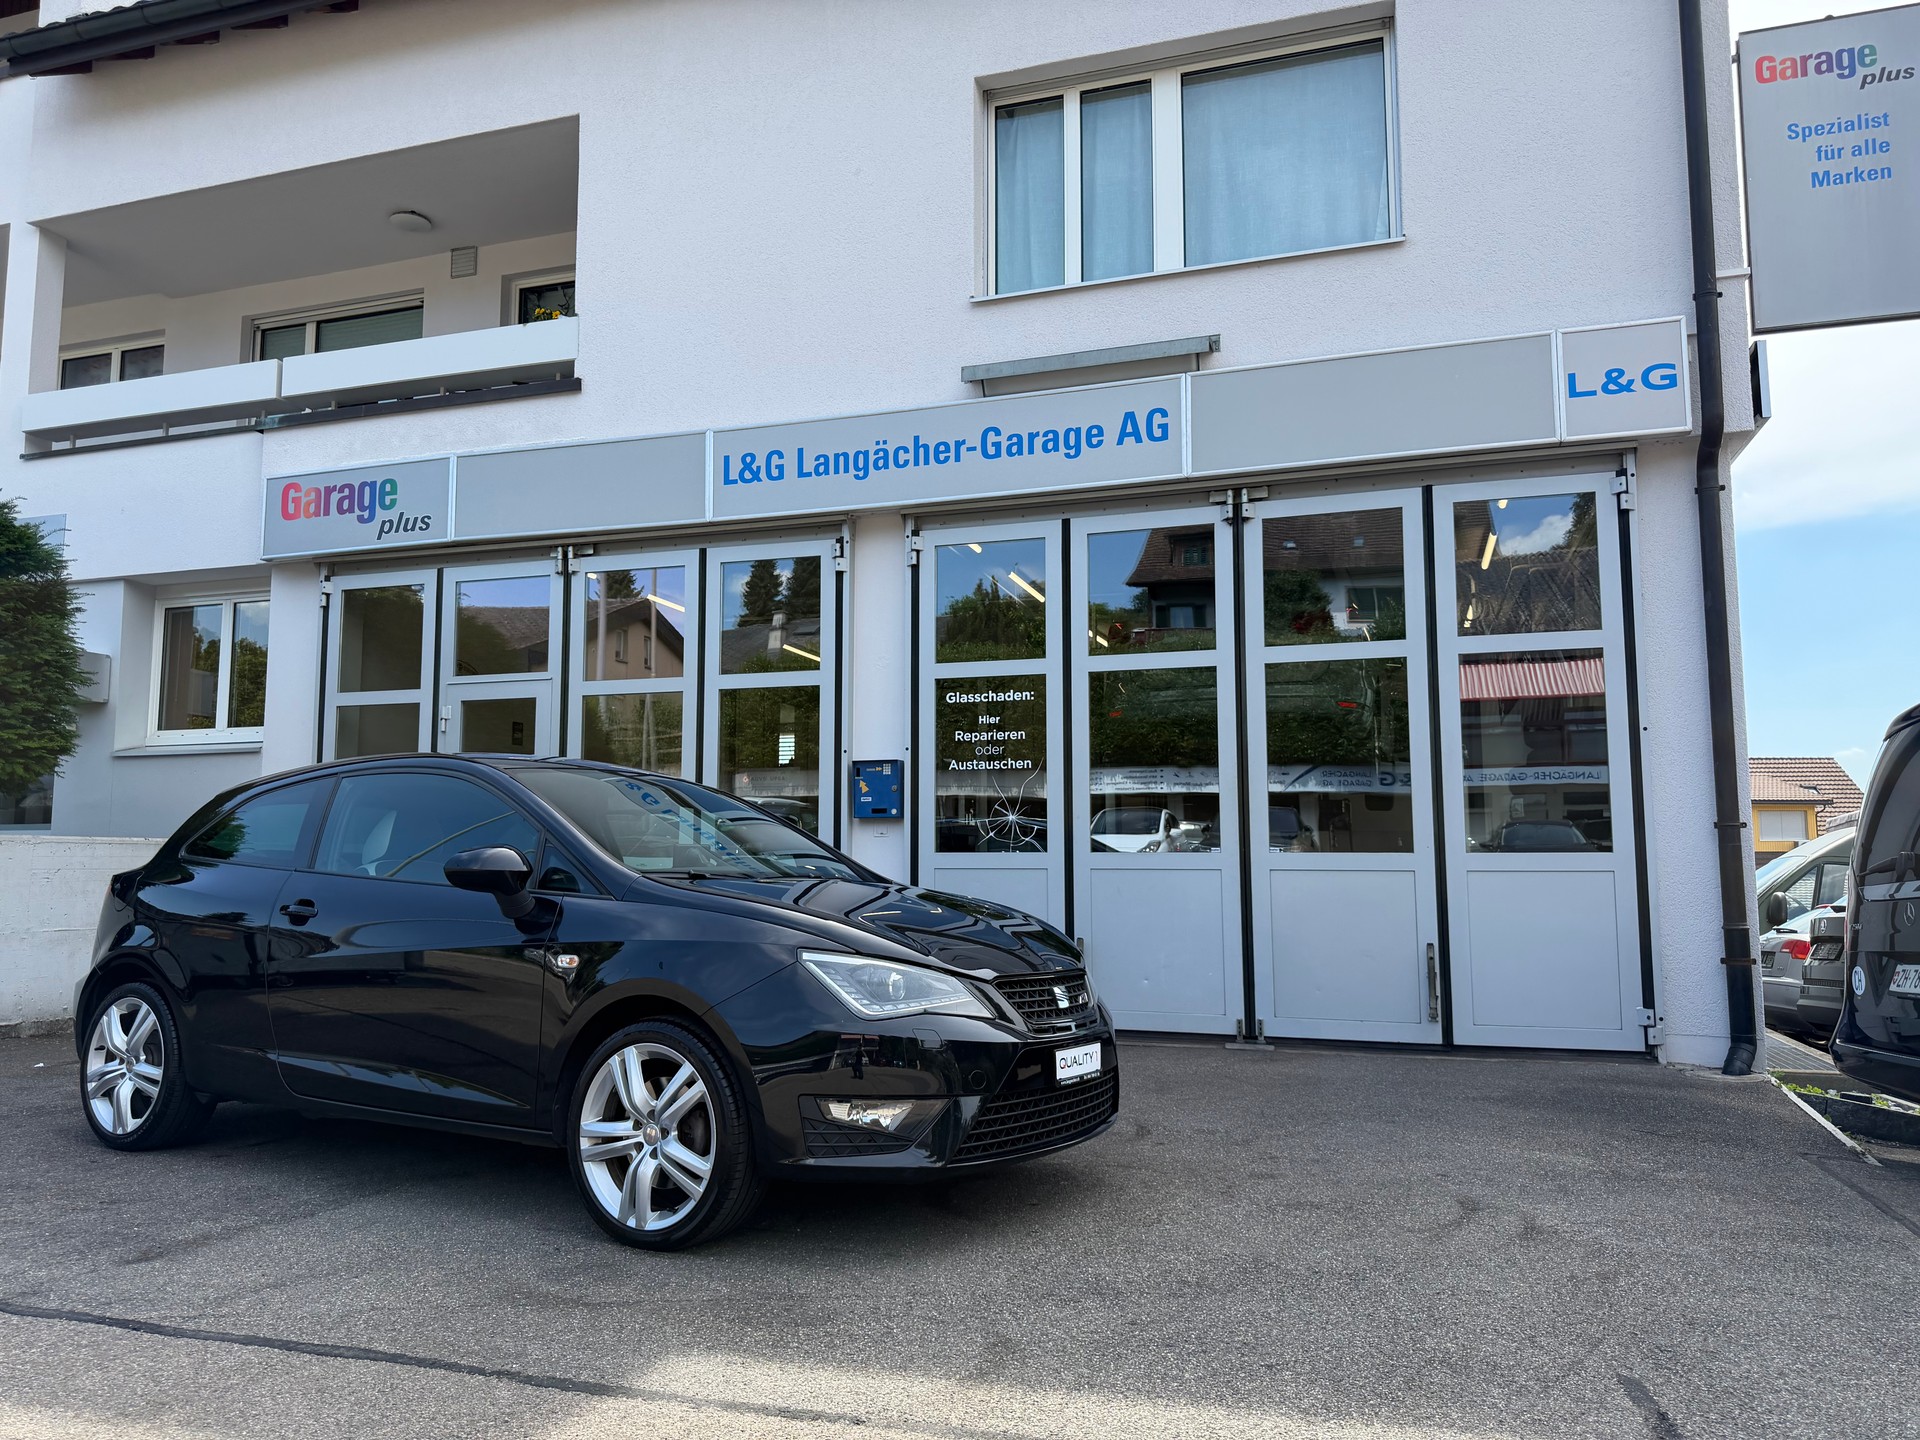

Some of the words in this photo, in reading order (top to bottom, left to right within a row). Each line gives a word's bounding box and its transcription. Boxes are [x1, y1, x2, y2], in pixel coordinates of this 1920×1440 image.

[1755, 44, 1878, 84] Garage
[1859, 66, 1916, 90] plus
[1786, 112, 1891, 143] Spezialist
[1815, 144, 1845, 162] für
[1850, 138, 1891, 158] alle
[1810, 166, 1893, 189] Marken
[1567, 362, 1679, 399] L&G
[722, 449, 785, 486] L&G
[796, 423, 1104, 481] Langächer-Garage
[1116, 407, 1170, 446] AG
[280, 477, 399, 524] Garage
[376, 511, 433, 541] plus
[945, 689, 1035, 703] Glasschaden:
[978, 715, 1000, 725] Hier
[954, 730, 1026, 743] Reparieren
[974, 744, 1005, 755] oder
[948, 758, 1032, 771] Austauschen
[1853, 970, 1863, 991] CH
[1059, 1051, 1094, 1070] QUALITY
